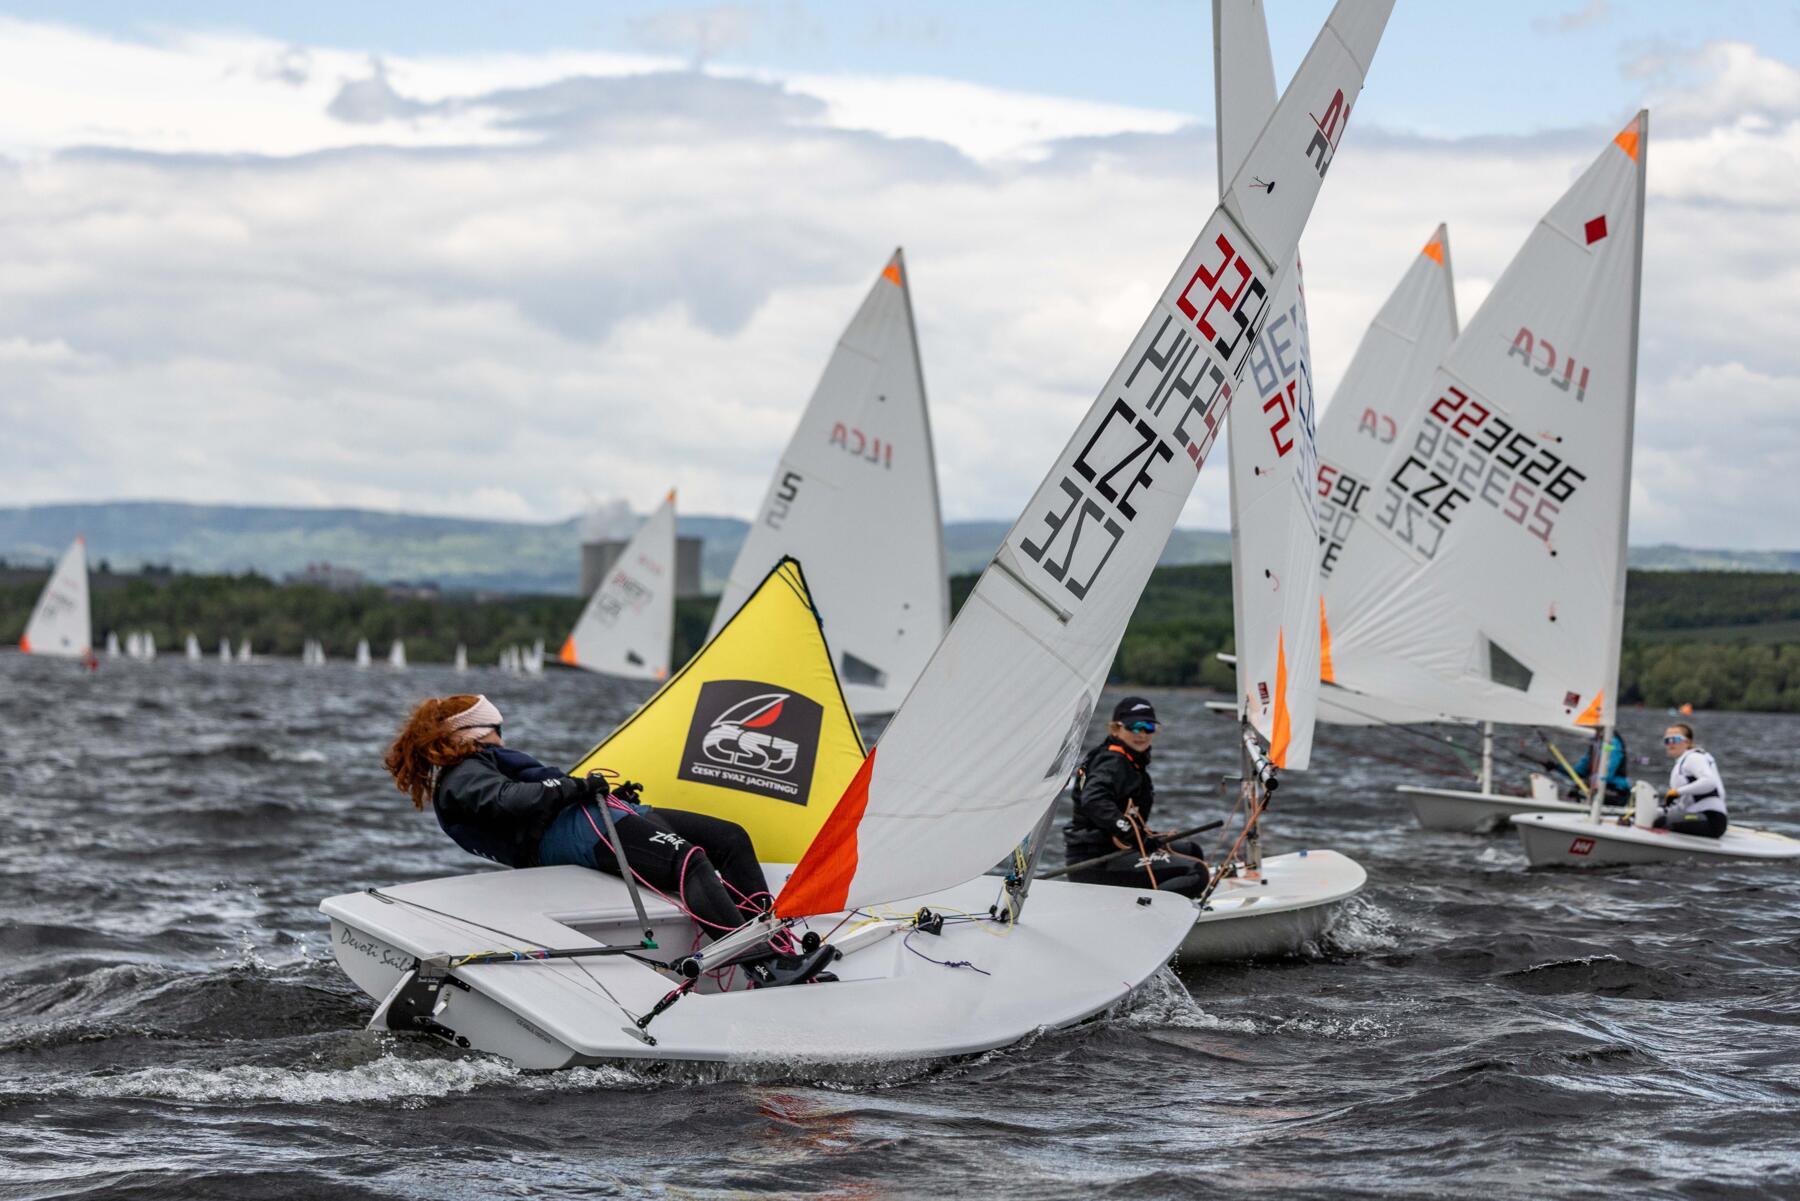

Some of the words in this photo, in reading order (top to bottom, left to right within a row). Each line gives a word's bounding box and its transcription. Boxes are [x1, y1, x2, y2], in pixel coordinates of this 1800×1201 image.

[1072, 397, 1174, 521] CZE
[1430, 386, 1587, 503] 223526
[1391, 456, 1471, 524] CZE
[721, 771, 746, 783] SVAZ
[746, 776, 798, 796] JACHTINGU
[341, 928, 378, 957] Devoti
